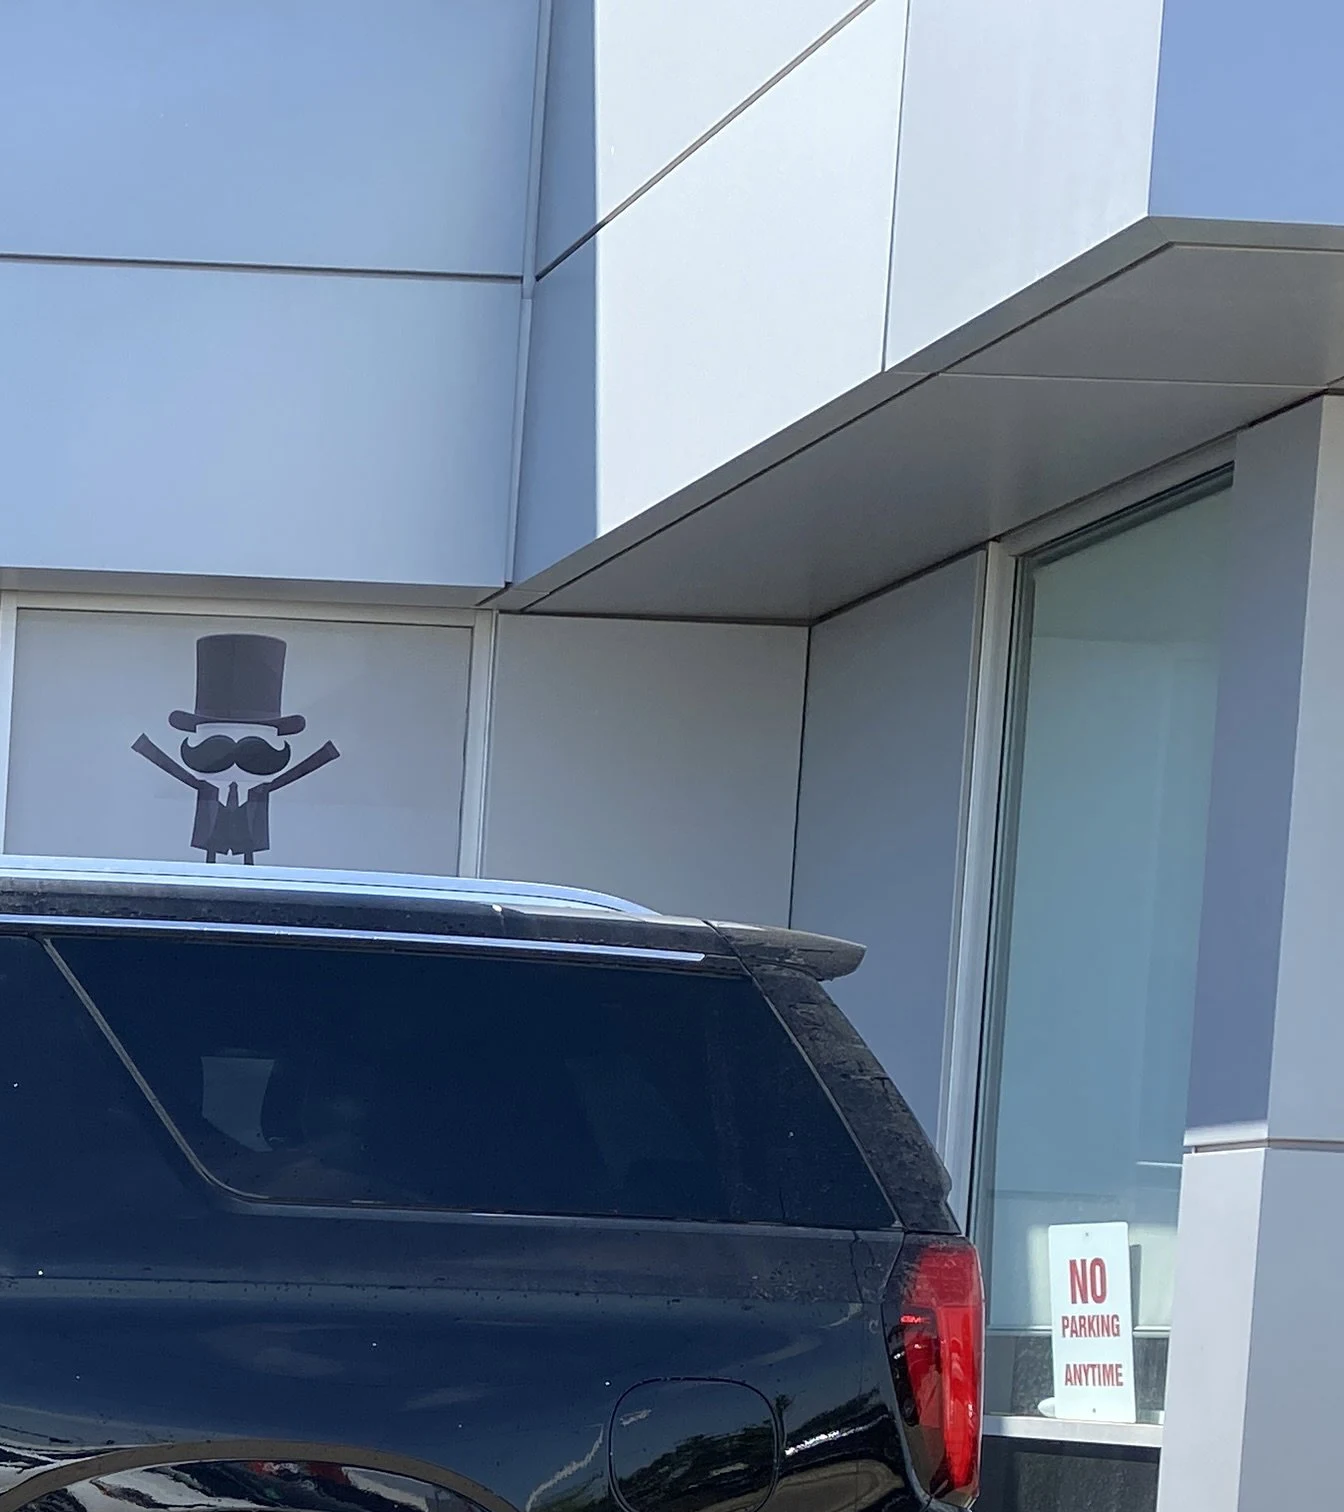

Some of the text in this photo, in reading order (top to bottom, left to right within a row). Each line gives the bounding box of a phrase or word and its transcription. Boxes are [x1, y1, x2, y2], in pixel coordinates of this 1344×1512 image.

[1068, 1257, 1108, 1305] NO
[1061, 1314, 1121, 1338] PARKING
[1064, 1363, 1124, 1387] ANYTIME
